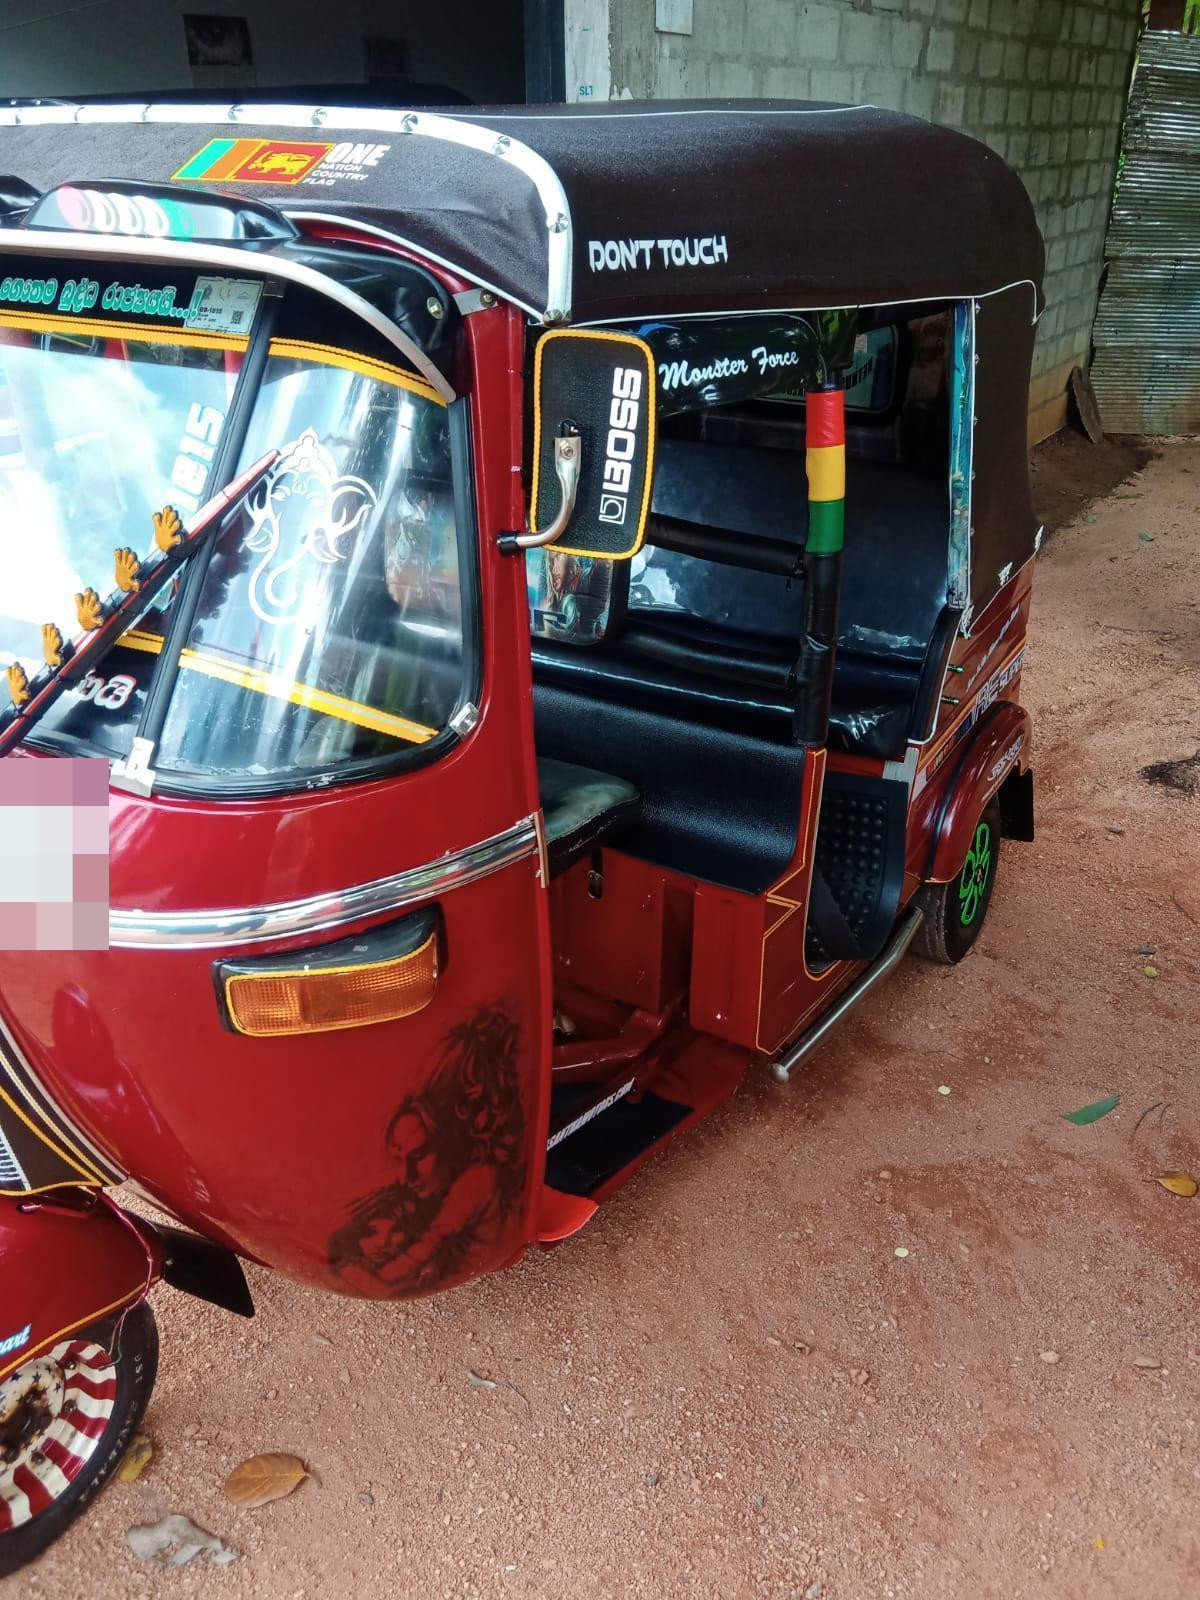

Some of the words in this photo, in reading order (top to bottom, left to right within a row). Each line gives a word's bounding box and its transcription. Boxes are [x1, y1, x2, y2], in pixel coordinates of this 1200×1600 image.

[325, 142, 391, 166] ONE
[311, 170, 369, 180] COUNTRY
[318, 162, 363, 172] NATION
[302, 177, 336, 186] FLAG
[588, 237, 656, 273] DON'T
[657, 234, 729, 270] TOUCH
[658, 356, 749, 391] Monster
[752, 345, 800, 375] Force
[601, 366, 642, 494] BOSS
